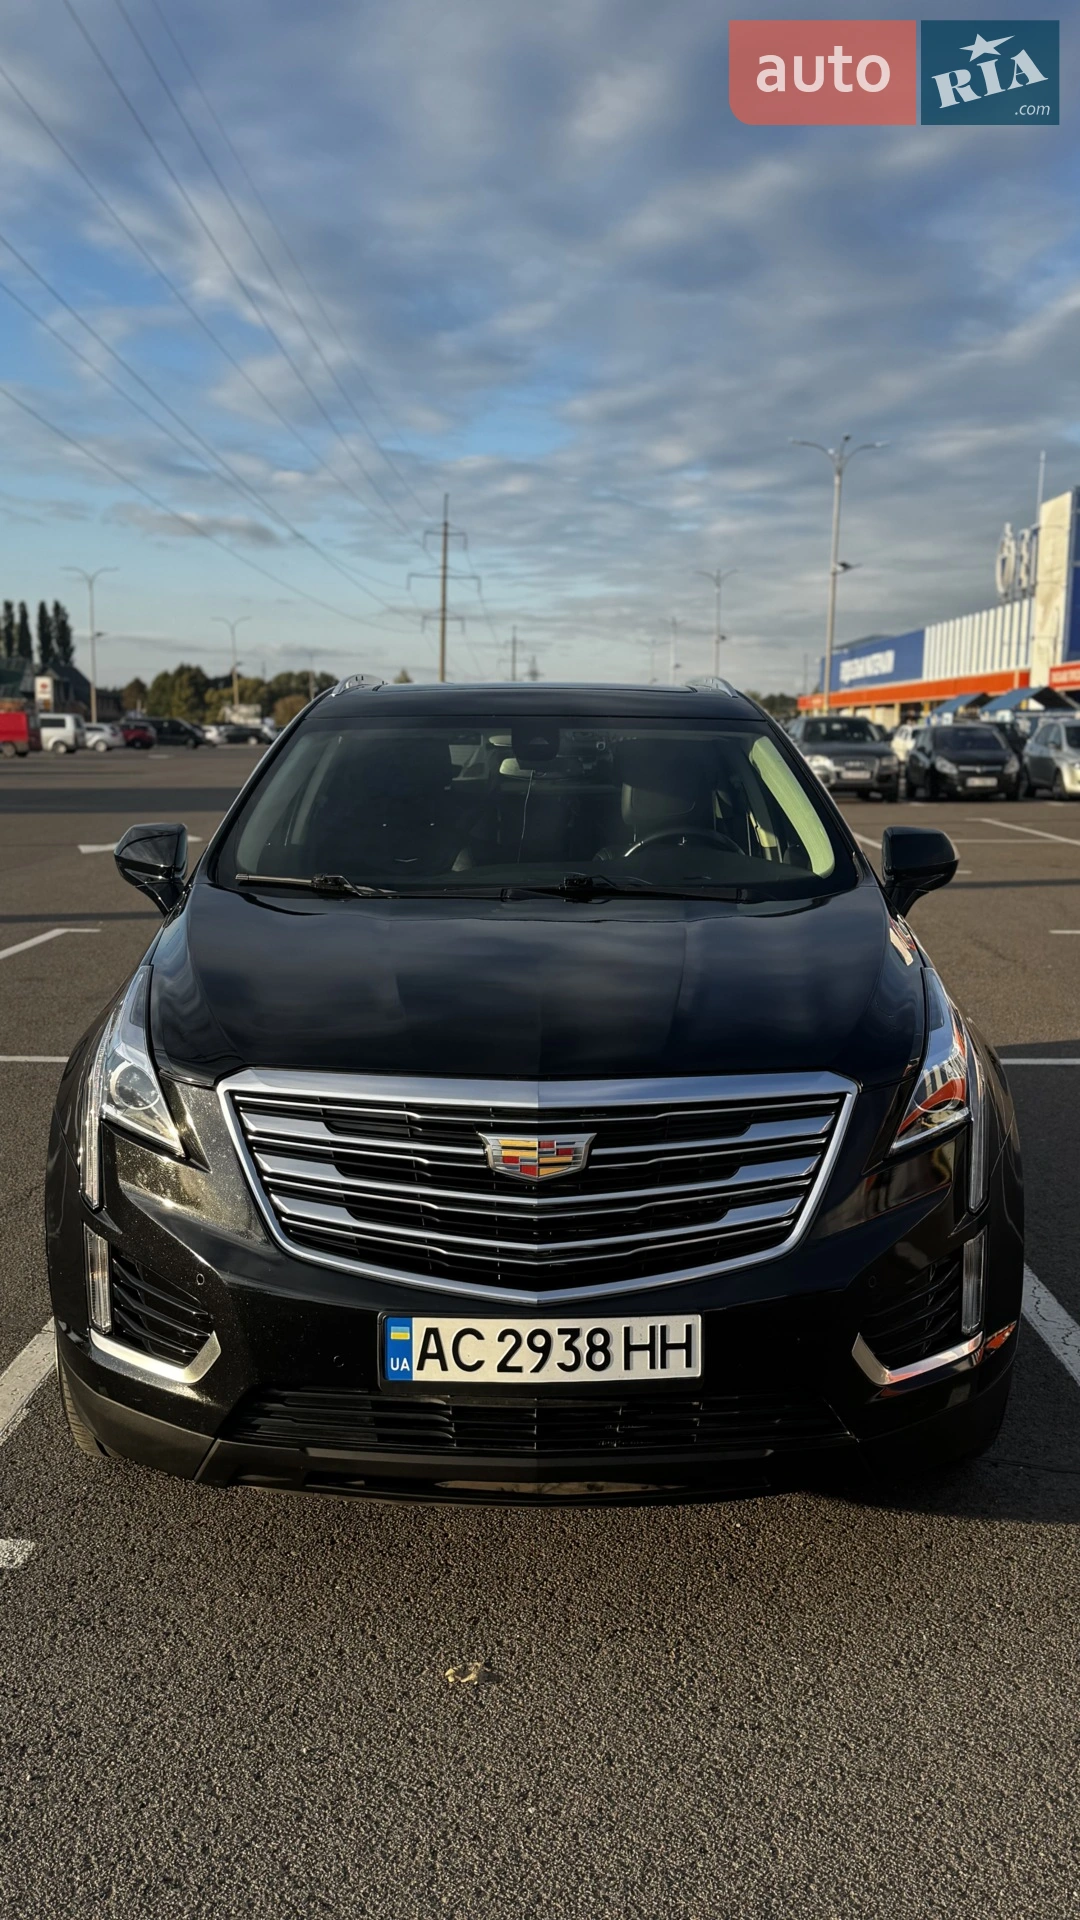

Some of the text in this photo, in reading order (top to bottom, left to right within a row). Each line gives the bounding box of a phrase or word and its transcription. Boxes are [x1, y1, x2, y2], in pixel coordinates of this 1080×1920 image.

[390, 1357, 410, 1372] UA
[416, 1323, 693, 1374] AC 2938 HH
